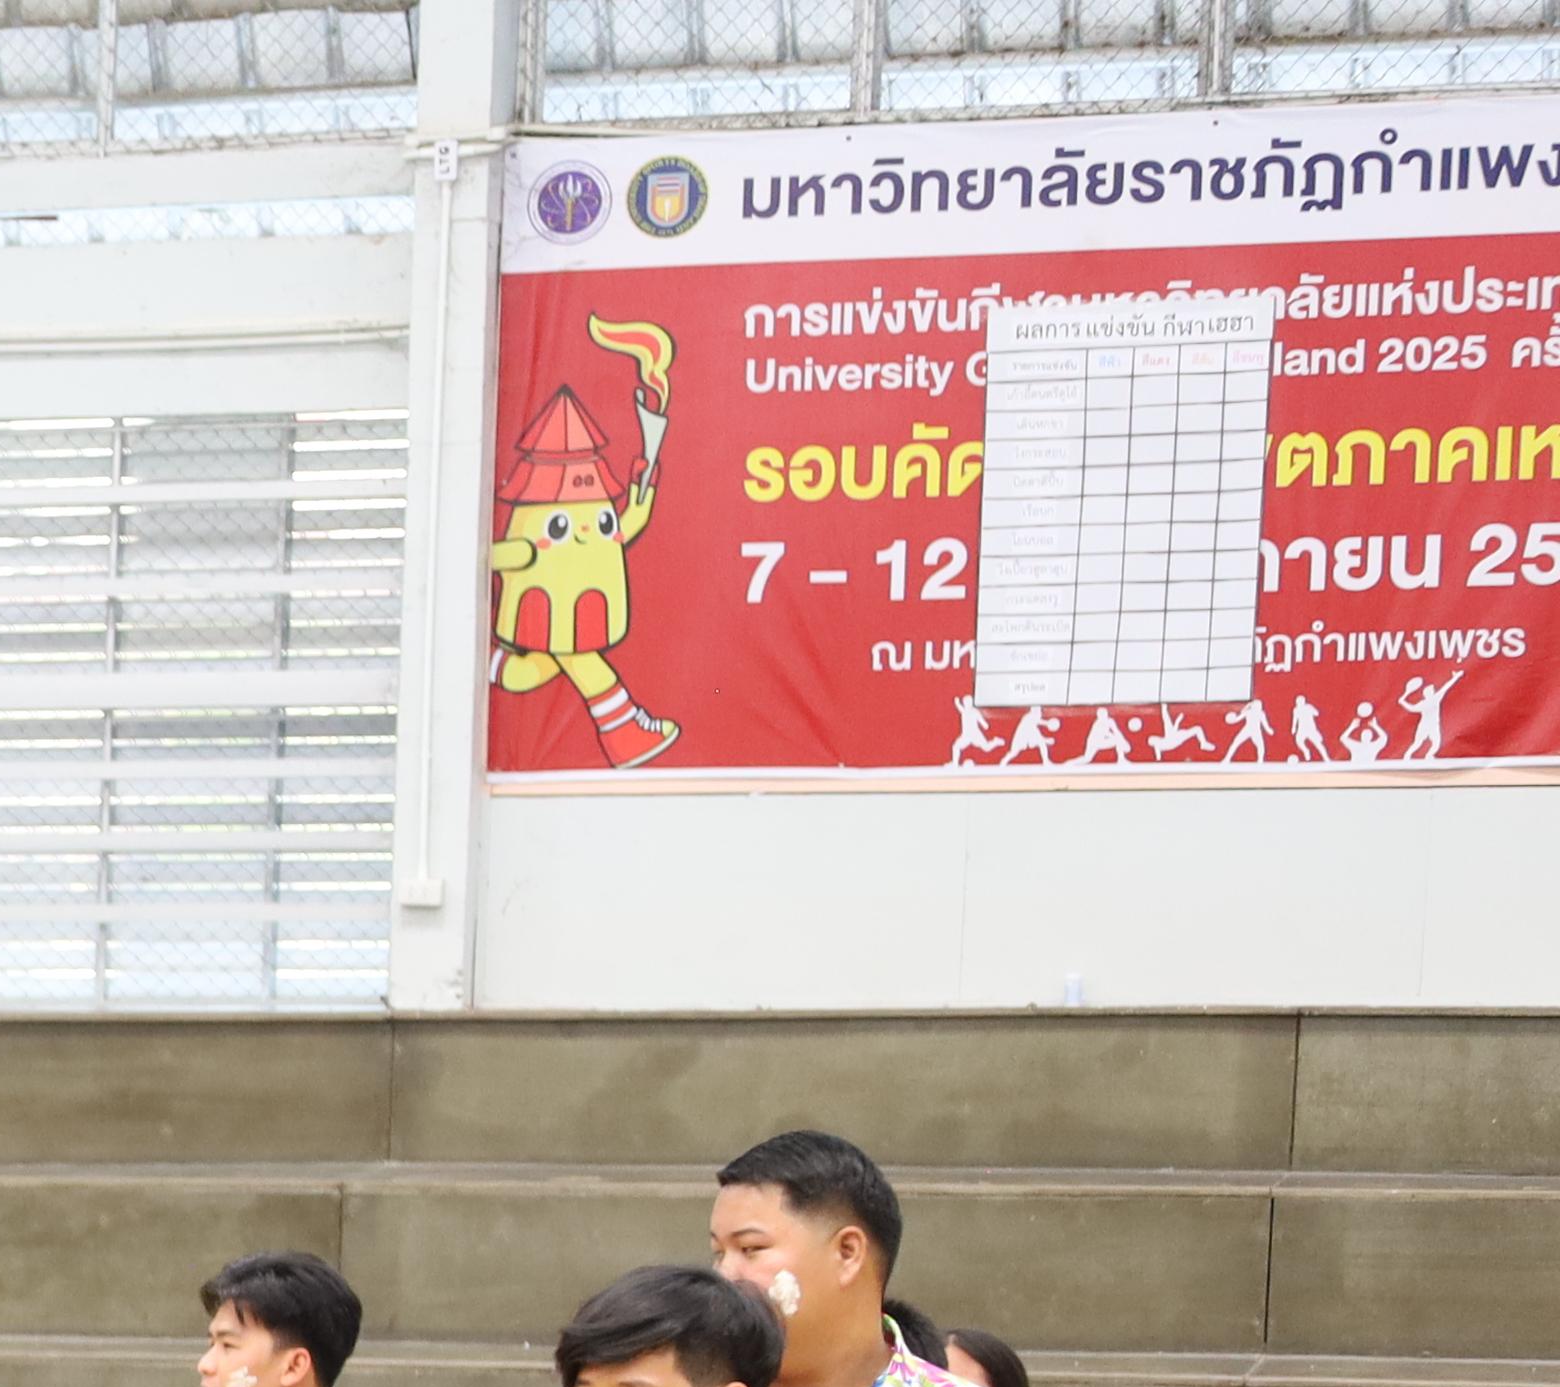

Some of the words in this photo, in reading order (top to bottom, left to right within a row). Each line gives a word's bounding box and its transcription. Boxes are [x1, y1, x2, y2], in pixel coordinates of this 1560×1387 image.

[745, 354, 954, 397] University
[1377, 335, 1488, 374] 2025
[740, 541, 785, 604] 7
[876, 536, 969, 602] 12
[871, 640, 913, 672] ณ
